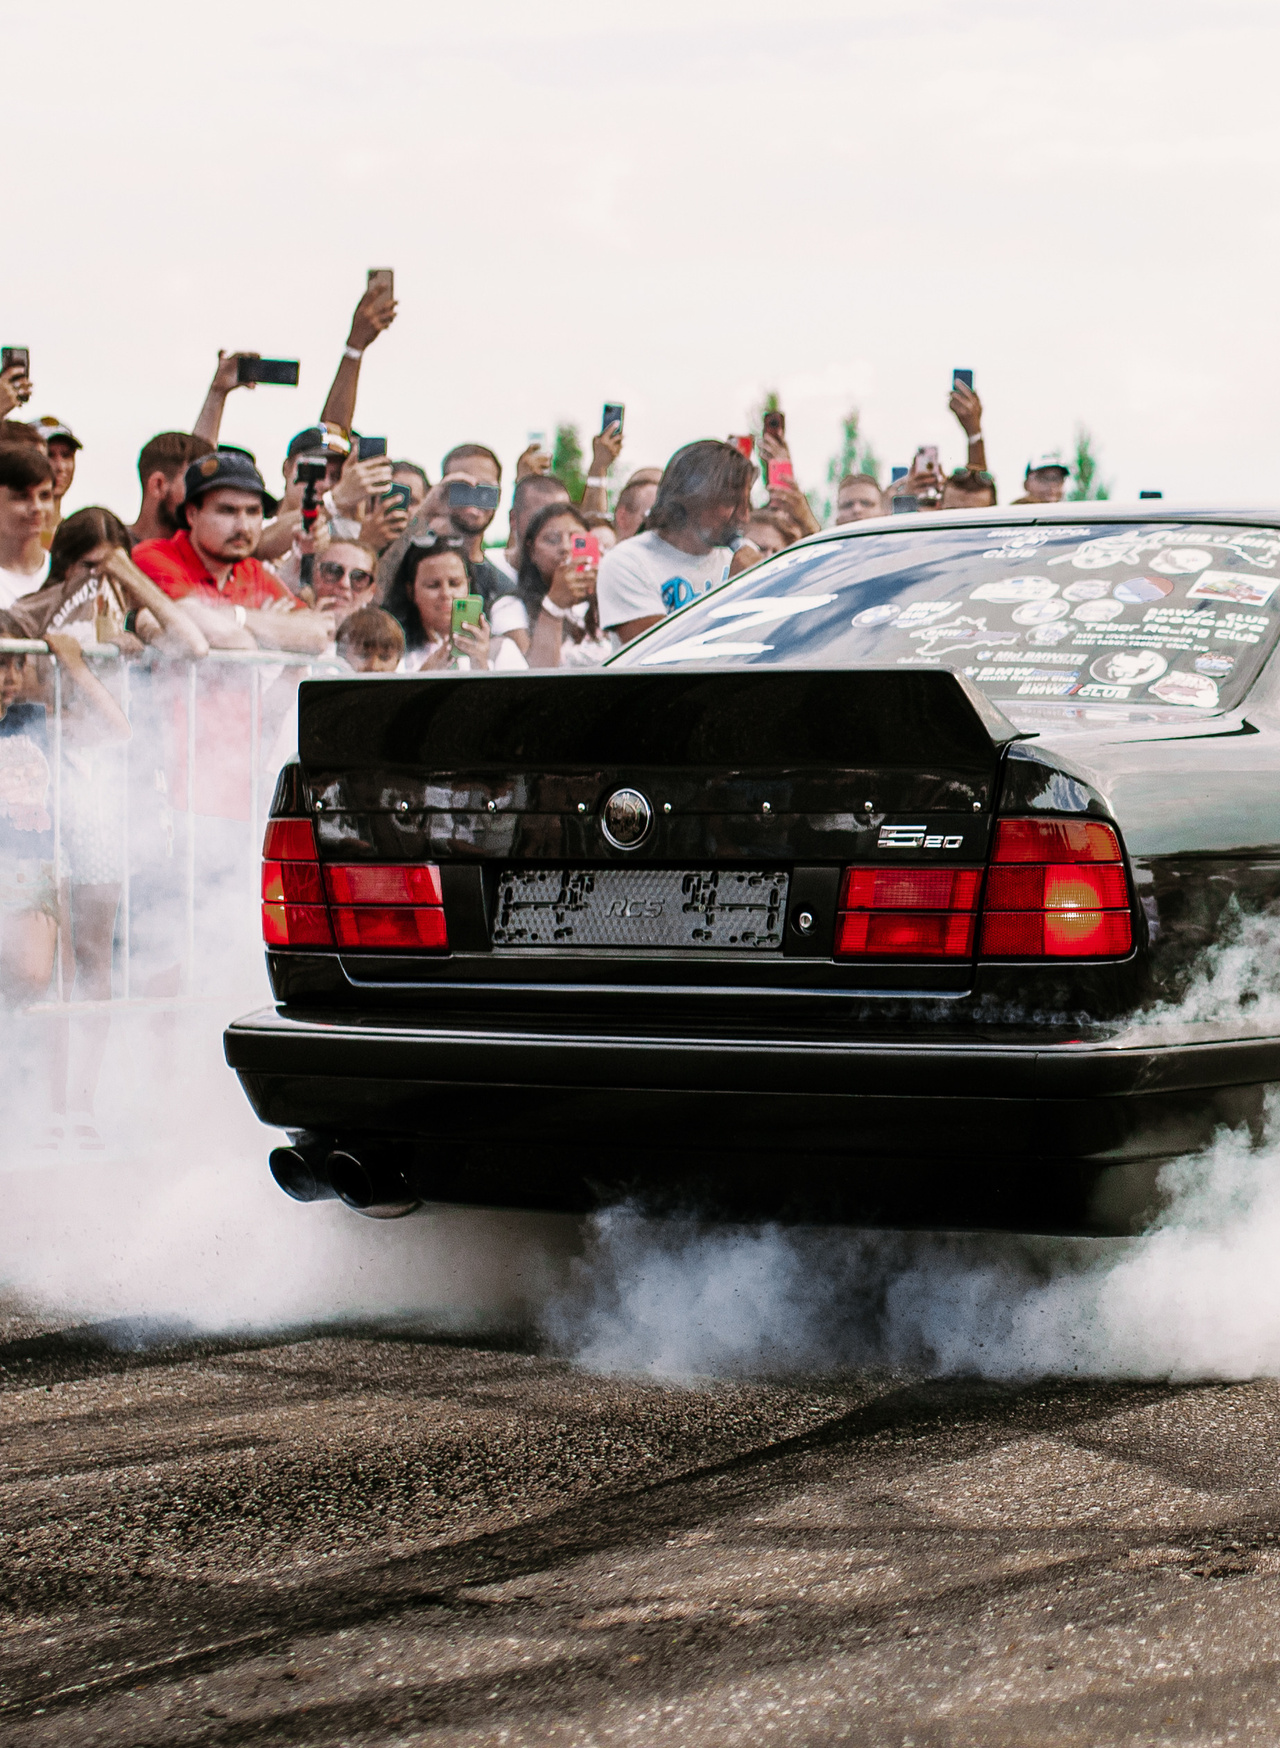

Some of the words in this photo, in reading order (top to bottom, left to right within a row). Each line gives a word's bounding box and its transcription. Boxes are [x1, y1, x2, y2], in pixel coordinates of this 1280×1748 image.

[1214, 628, 1260, 643] Club
[980, 667, 1036, 676] BMW
[877, 825, 964, 848] 520
